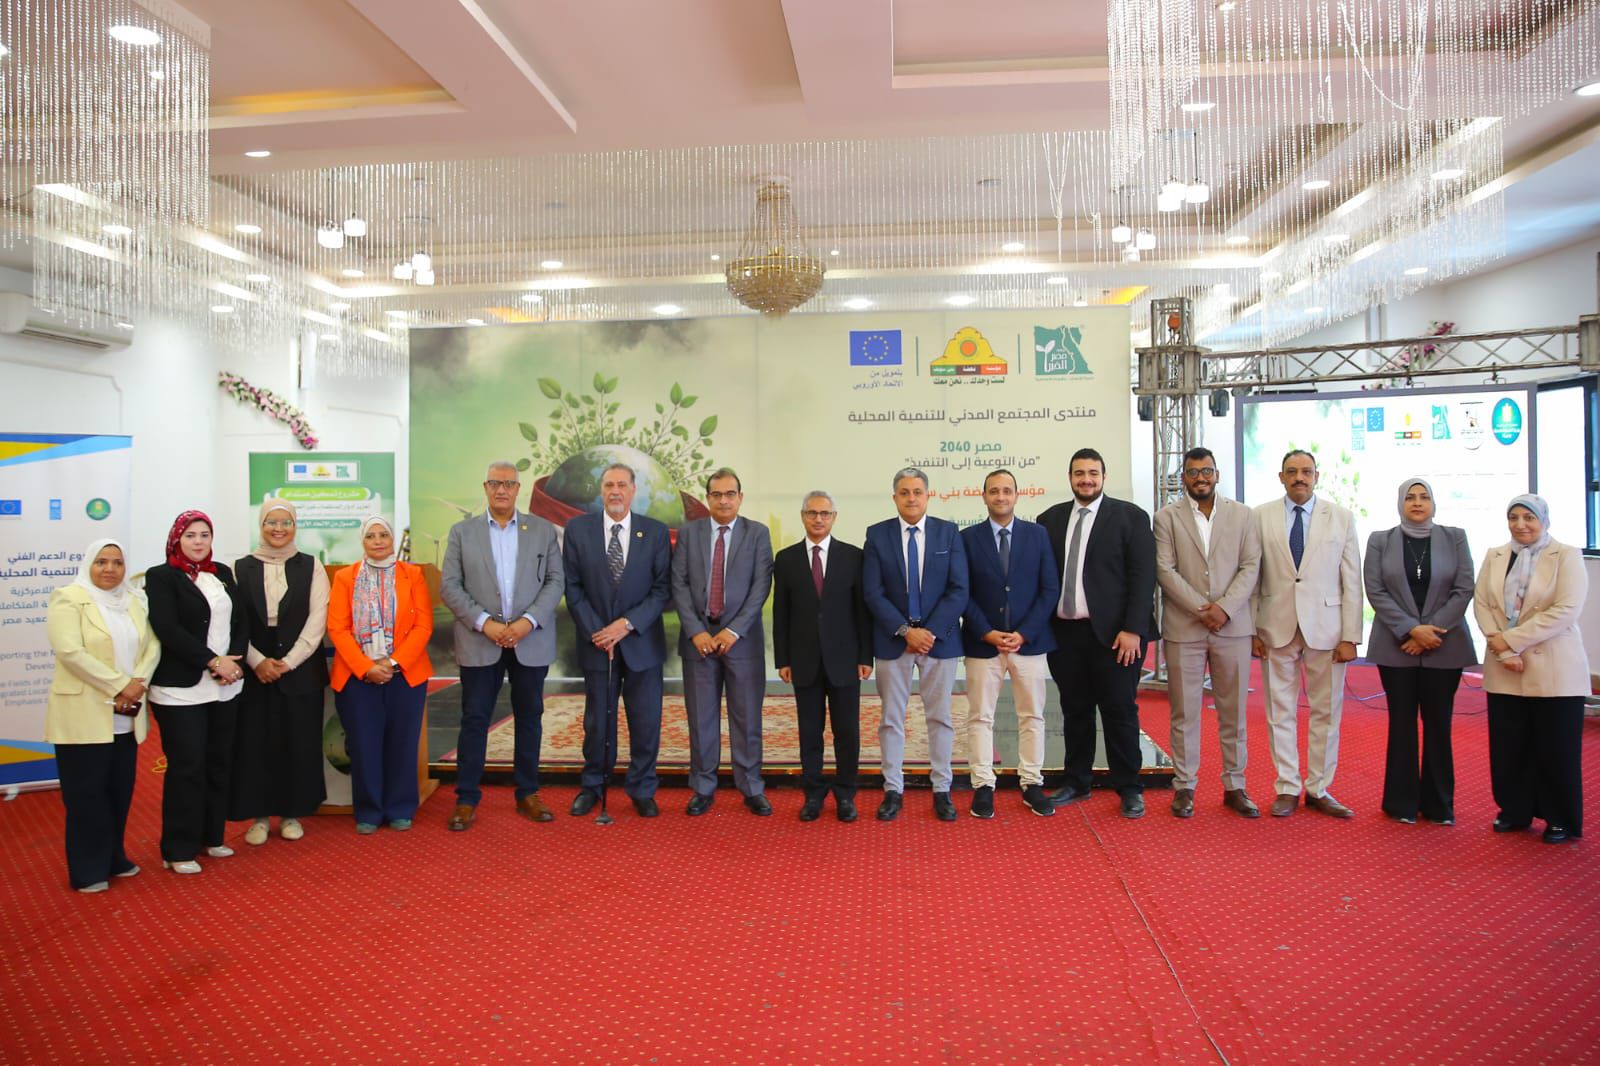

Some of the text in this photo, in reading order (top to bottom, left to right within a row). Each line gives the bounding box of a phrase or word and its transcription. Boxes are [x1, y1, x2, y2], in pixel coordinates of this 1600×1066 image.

[869, 369, 880, 378] من
[847, 406, 1097, 427] منتدى المجتمع المدني للتنمية المحلية
[939, 440, 1003, 455] مصر 2040
[951, 456, 972, 471] إلى
[973, 455, 1016, 470] التوعية
[939, 486, 961, 502] بني
[7, 552, 35, 565] الفني
[38, 552, 66, 562] الدعم
[0, 566, 79, 580] التنمية المحلي
[0, 600, 39, 610] المتكامل
[2, 617, 22, 627] مصر
[0, 652, 32, 661] porting
[25, 663, 55, 671] Develo
